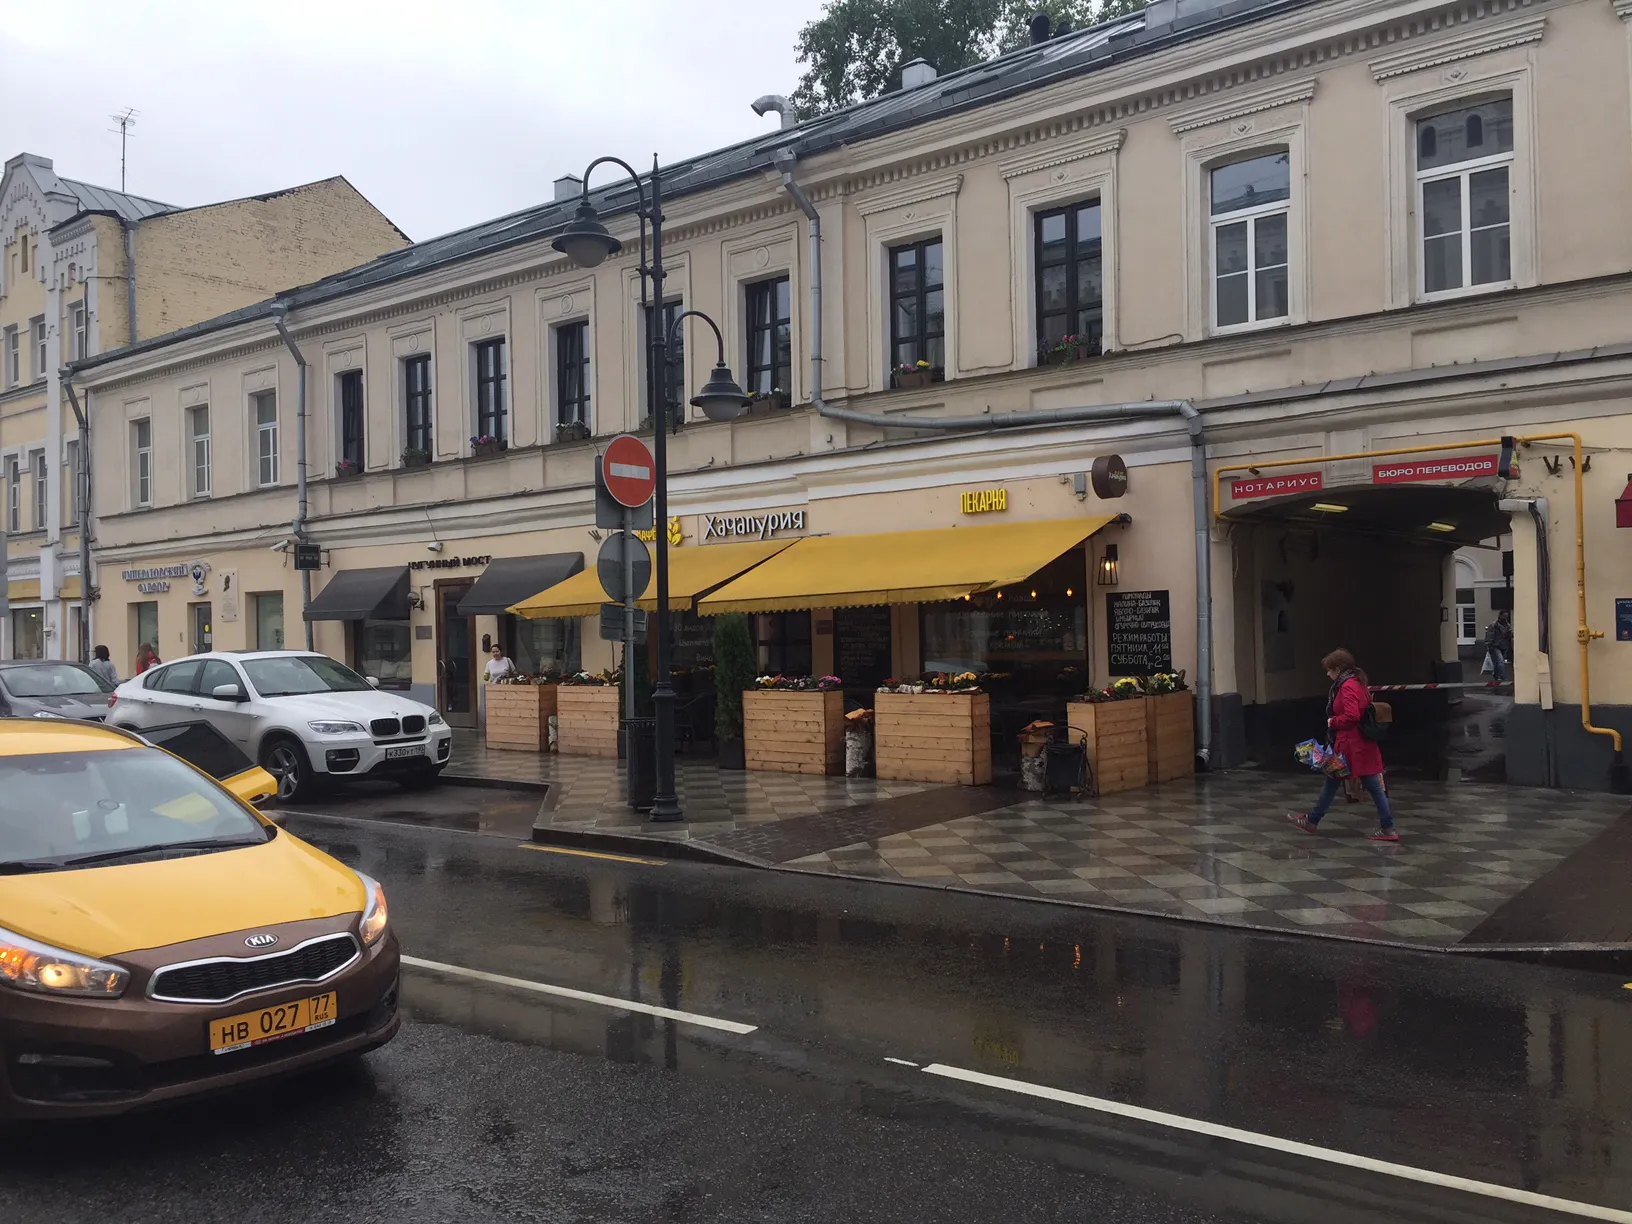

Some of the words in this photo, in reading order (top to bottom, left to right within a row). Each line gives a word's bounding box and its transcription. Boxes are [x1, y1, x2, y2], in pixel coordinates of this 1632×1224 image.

[1378, 468, 1414, 478] БЮРО
[1416, 461, 1492, 475] ПЕРЕВОДОВ
[1234, 477, 1319, 493] НОТАРИУС
[960, 488, 1008, 515] ПЕКАРНЯ
[703, 511, 805, 540] Хачапурия
[408, 556, 461, 570] ЧУГУННЫЙ
[462, 555, 492, 567] МОСТ
[122, 563, 189, 581] ИМПЕРАТОРСКИЙ
[1112, 633, 1139, 642] РЕЖИМ
[250, 935, 275, 946] KIA
[260, 1003, 299, 1034] 027
[311, 995, 330, 1014] 77
[314, 1012, 329, 1021] RUS
